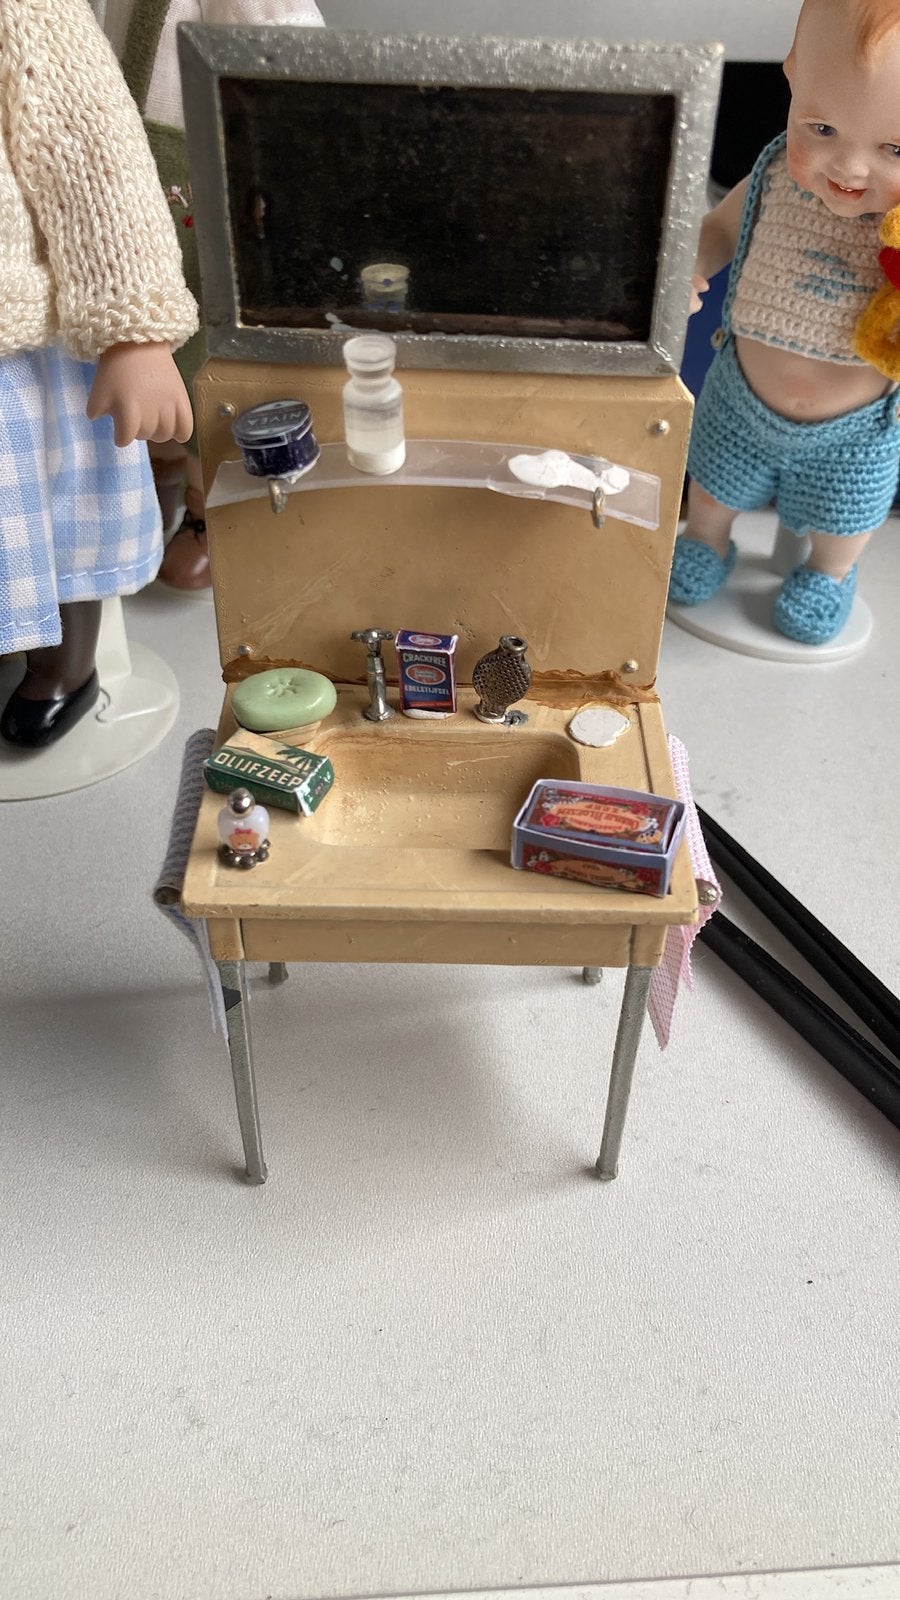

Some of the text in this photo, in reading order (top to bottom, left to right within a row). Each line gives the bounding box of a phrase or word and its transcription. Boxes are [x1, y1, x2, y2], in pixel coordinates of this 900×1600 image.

[248, 412, 302, 426] NIVEA
[403, 653, 447, 668] CRACKFREE
[213, 752, 303, 787] OLIJFZEEP
